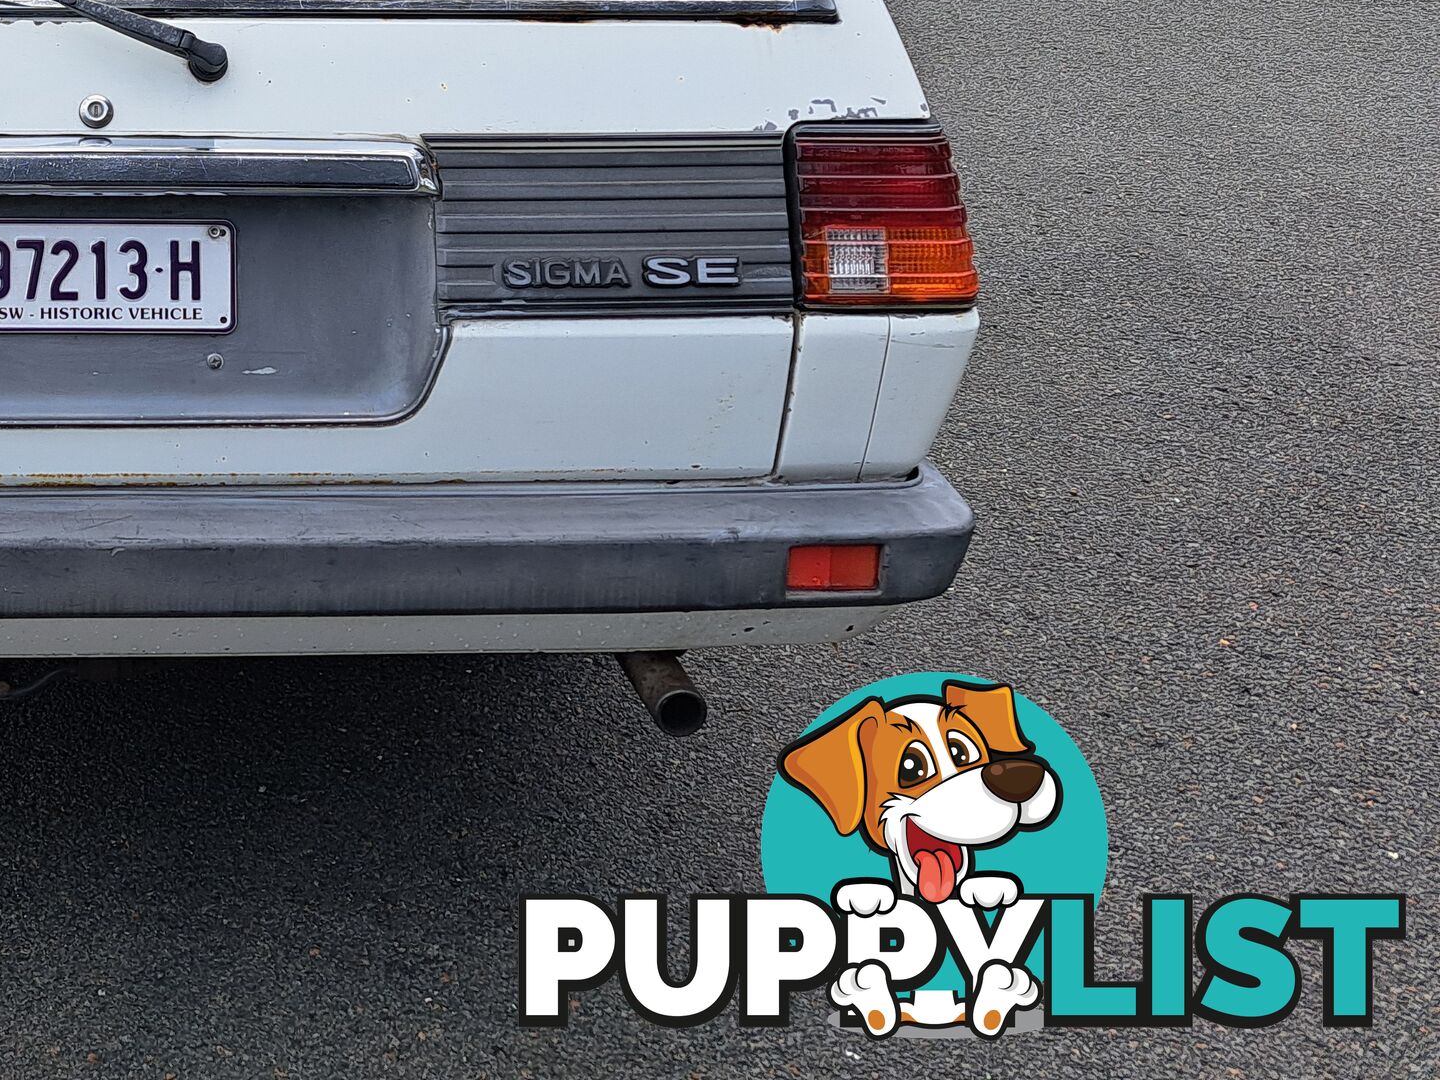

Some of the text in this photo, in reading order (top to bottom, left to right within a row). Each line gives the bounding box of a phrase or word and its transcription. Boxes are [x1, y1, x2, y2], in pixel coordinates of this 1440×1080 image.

[509, 257, 739, 286] SIGMA SE
[40, 307, 124, 320] HISTORIC
[129, 308, 203, 320] VEHICLE
